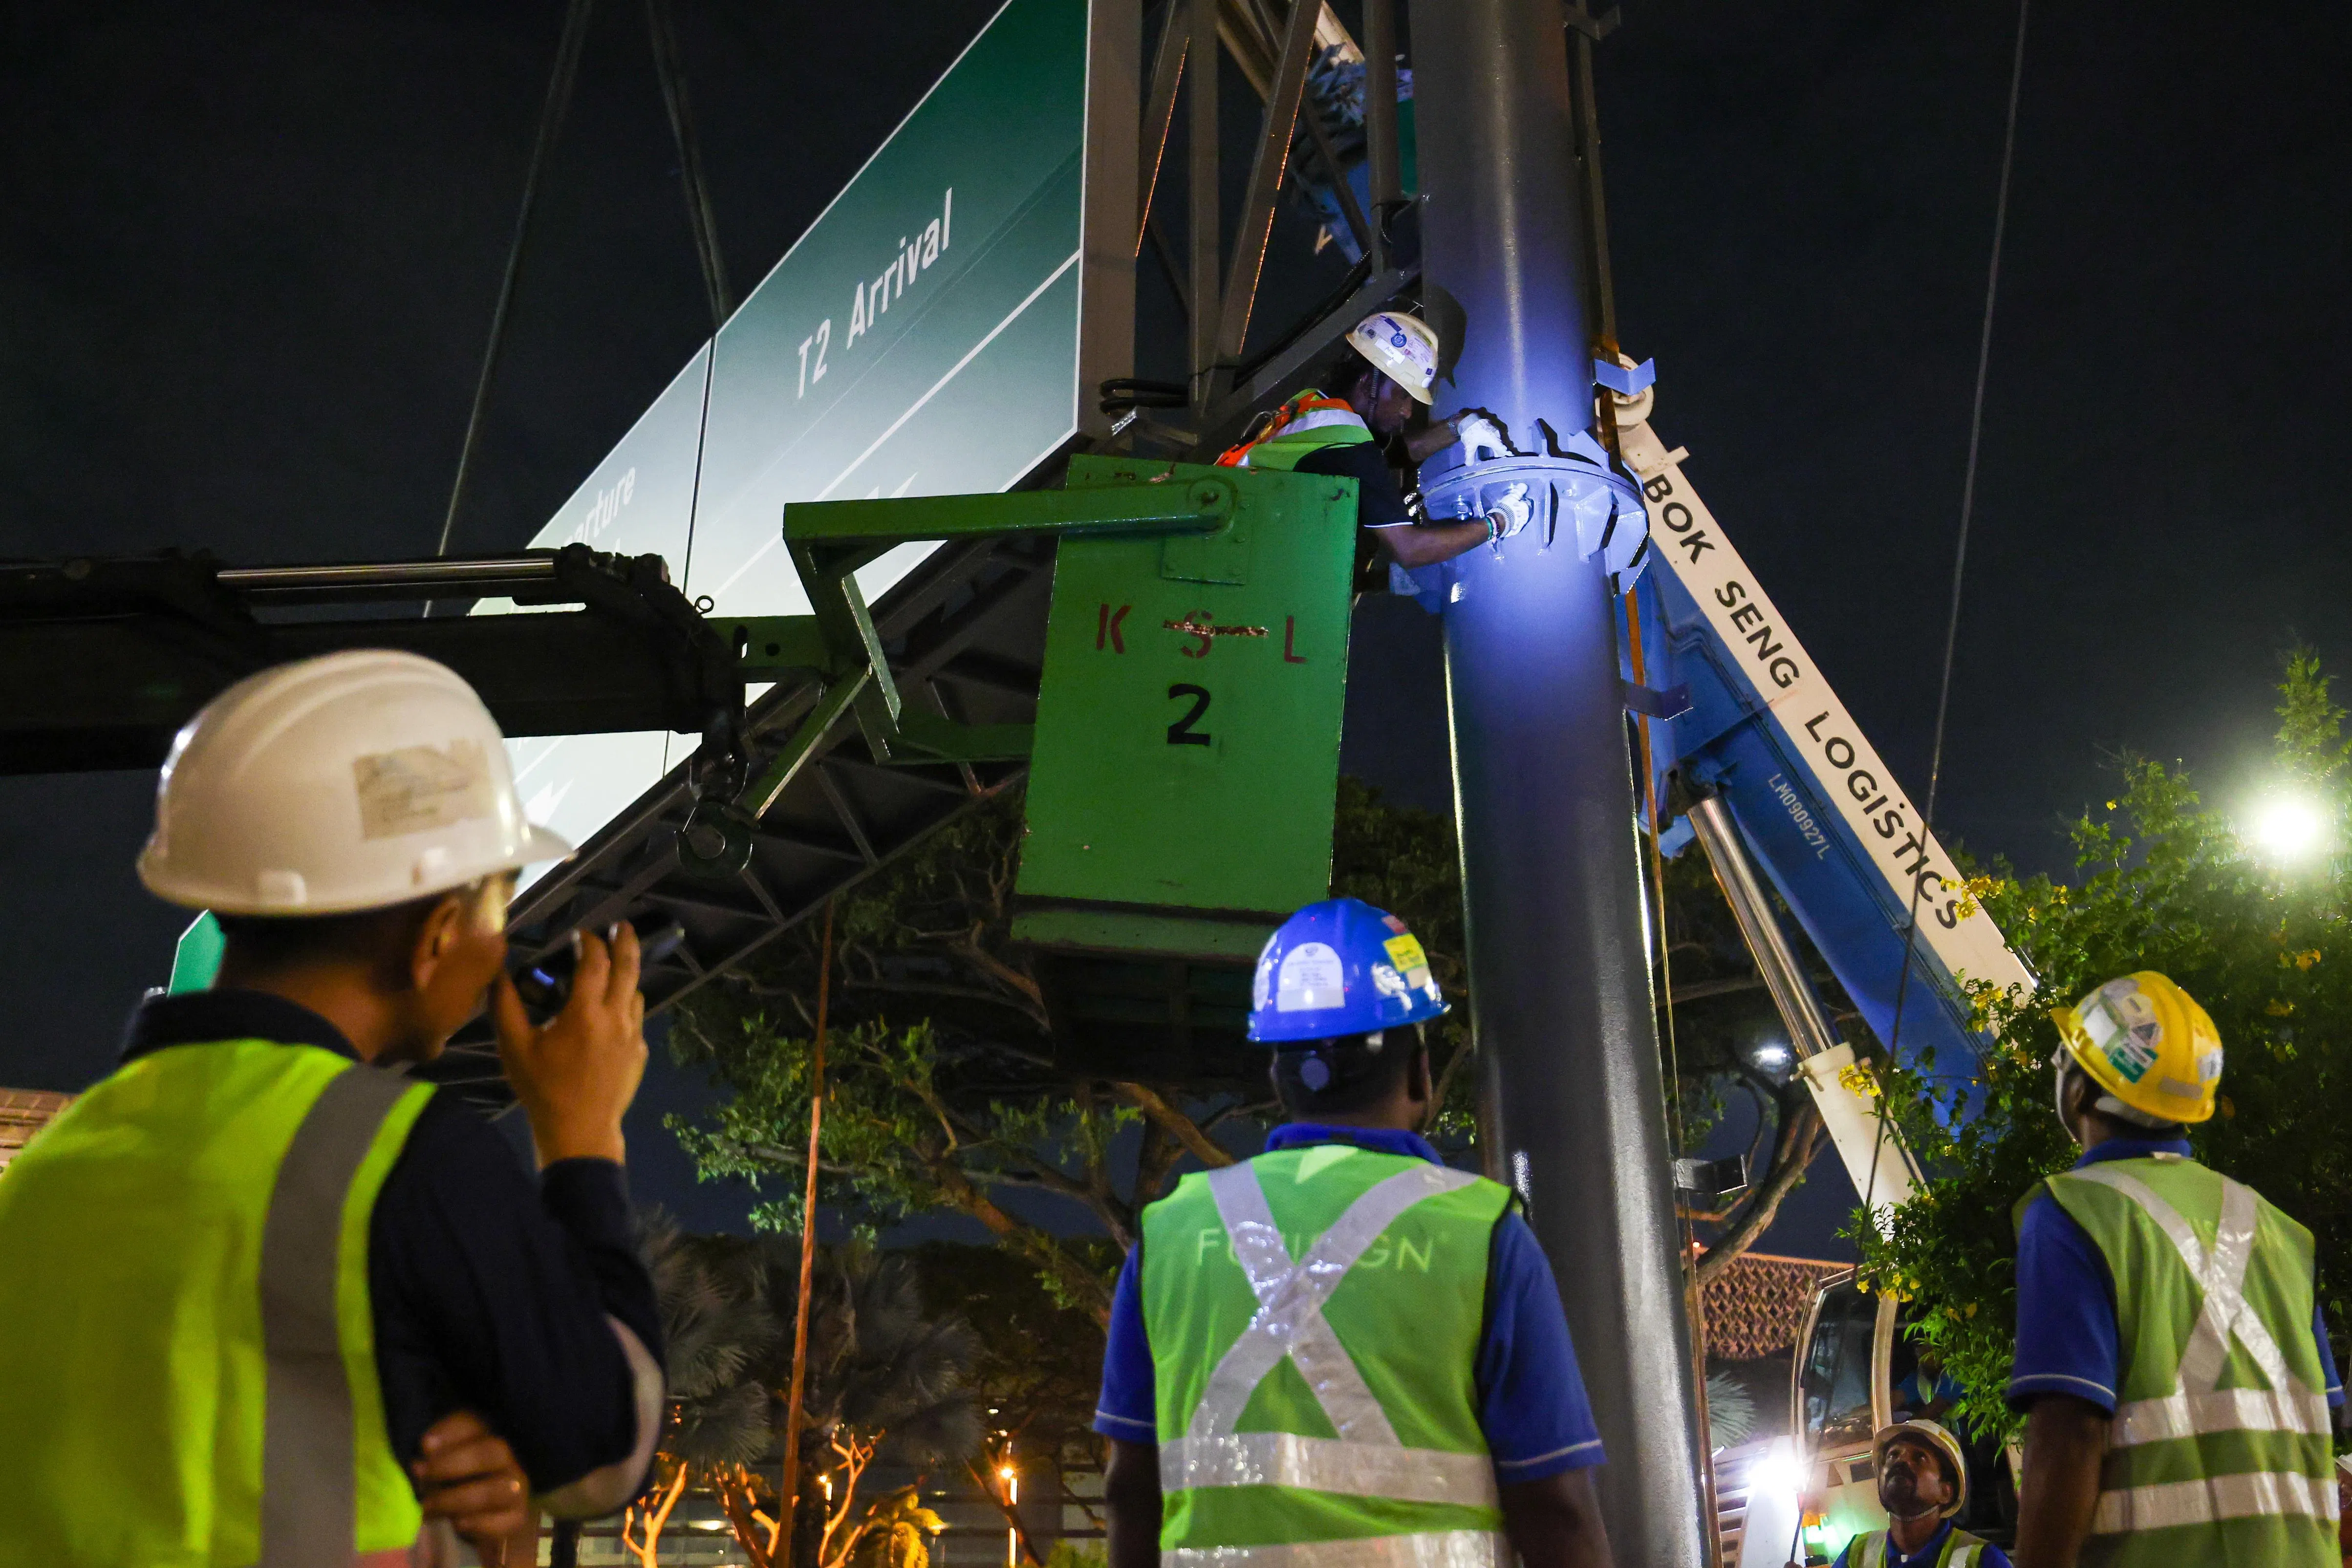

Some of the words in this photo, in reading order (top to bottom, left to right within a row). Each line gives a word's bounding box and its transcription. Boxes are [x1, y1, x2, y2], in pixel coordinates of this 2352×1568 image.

[798, 319, 831, 399] T2
[846, 187, 952, 350] Arrival
[1096, 603, 1132, 654] K
[1284, 615, 1308, 664] L
[1167, 683, 1211, 746] 2
[1643, 473, 1715, 565] BOK
[1715, 580, 1800, 688] SENG
[1805, 711, 1959, 929] LOGISTICS
[1768, 773, 1831, 860] LM090927L
